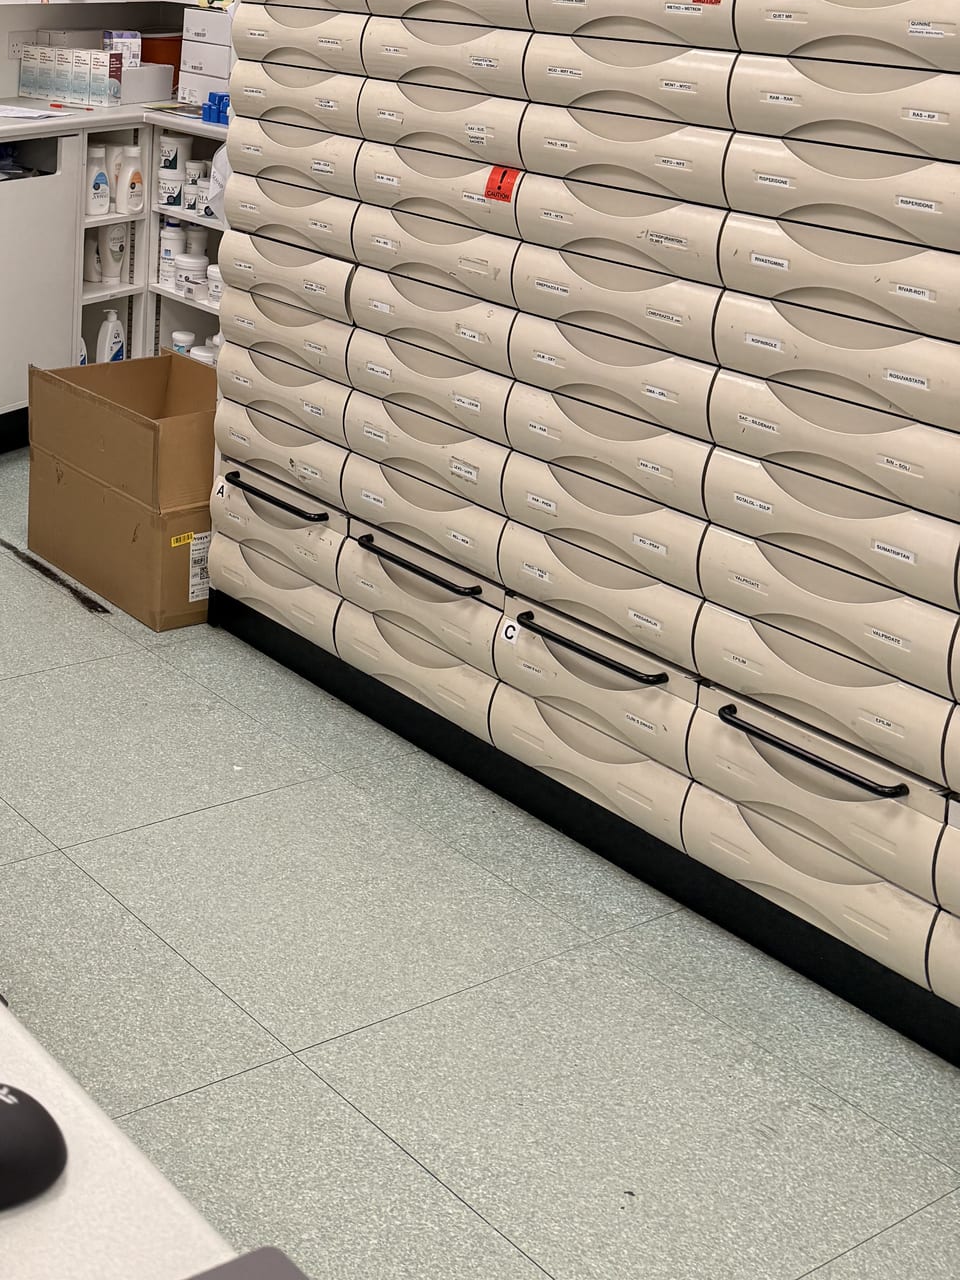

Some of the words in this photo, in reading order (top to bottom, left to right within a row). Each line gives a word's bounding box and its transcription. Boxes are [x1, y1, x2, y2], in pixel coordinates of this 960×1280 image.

[486, 191, 509, 200] CAUTION
[900, 199, 933, 209] RISPERIDONE
[889, 373, 925, 386] ROSUVASTATIN
[217, 485, 225, 497] A
[876, 544, 910, 560] SUMATRIPTAN
[735, 575, 760, 588] VALPROATE
[505, 624, 516, 640] C
[873, 630, 901, 644] VALPROATE
